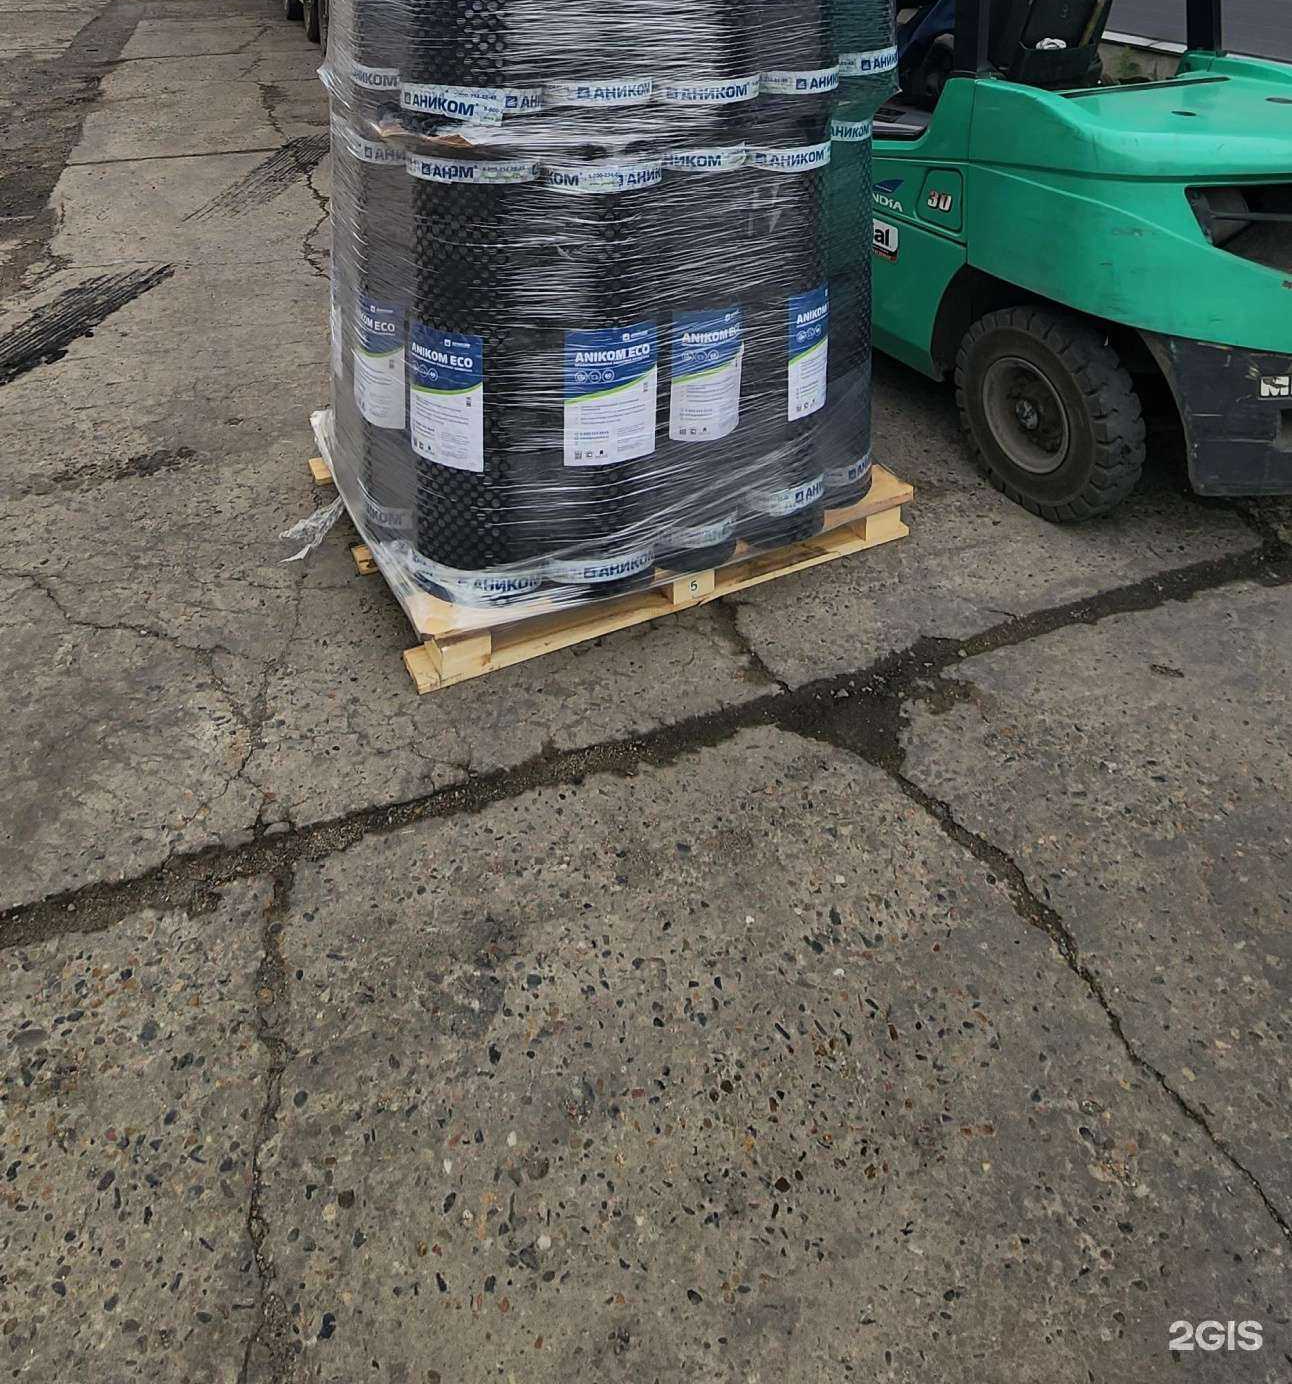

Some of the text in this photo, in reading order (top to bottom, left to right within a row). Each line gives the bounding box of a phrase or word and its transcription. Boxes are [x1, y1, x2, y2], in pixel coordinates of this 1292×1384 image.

[412, 94, 475, 116] АНИКОМ
[770, 151, 825, 167] АНИКОМ
[927, 190, 953, 212] 30
[374, 321, 395, 332] ECO
[682, 329, 729, 343] ANIKOM
[411, 342, 473, 368] ANIKOM ECO
[575, 343, 650, 363] ANIKOM ECO
